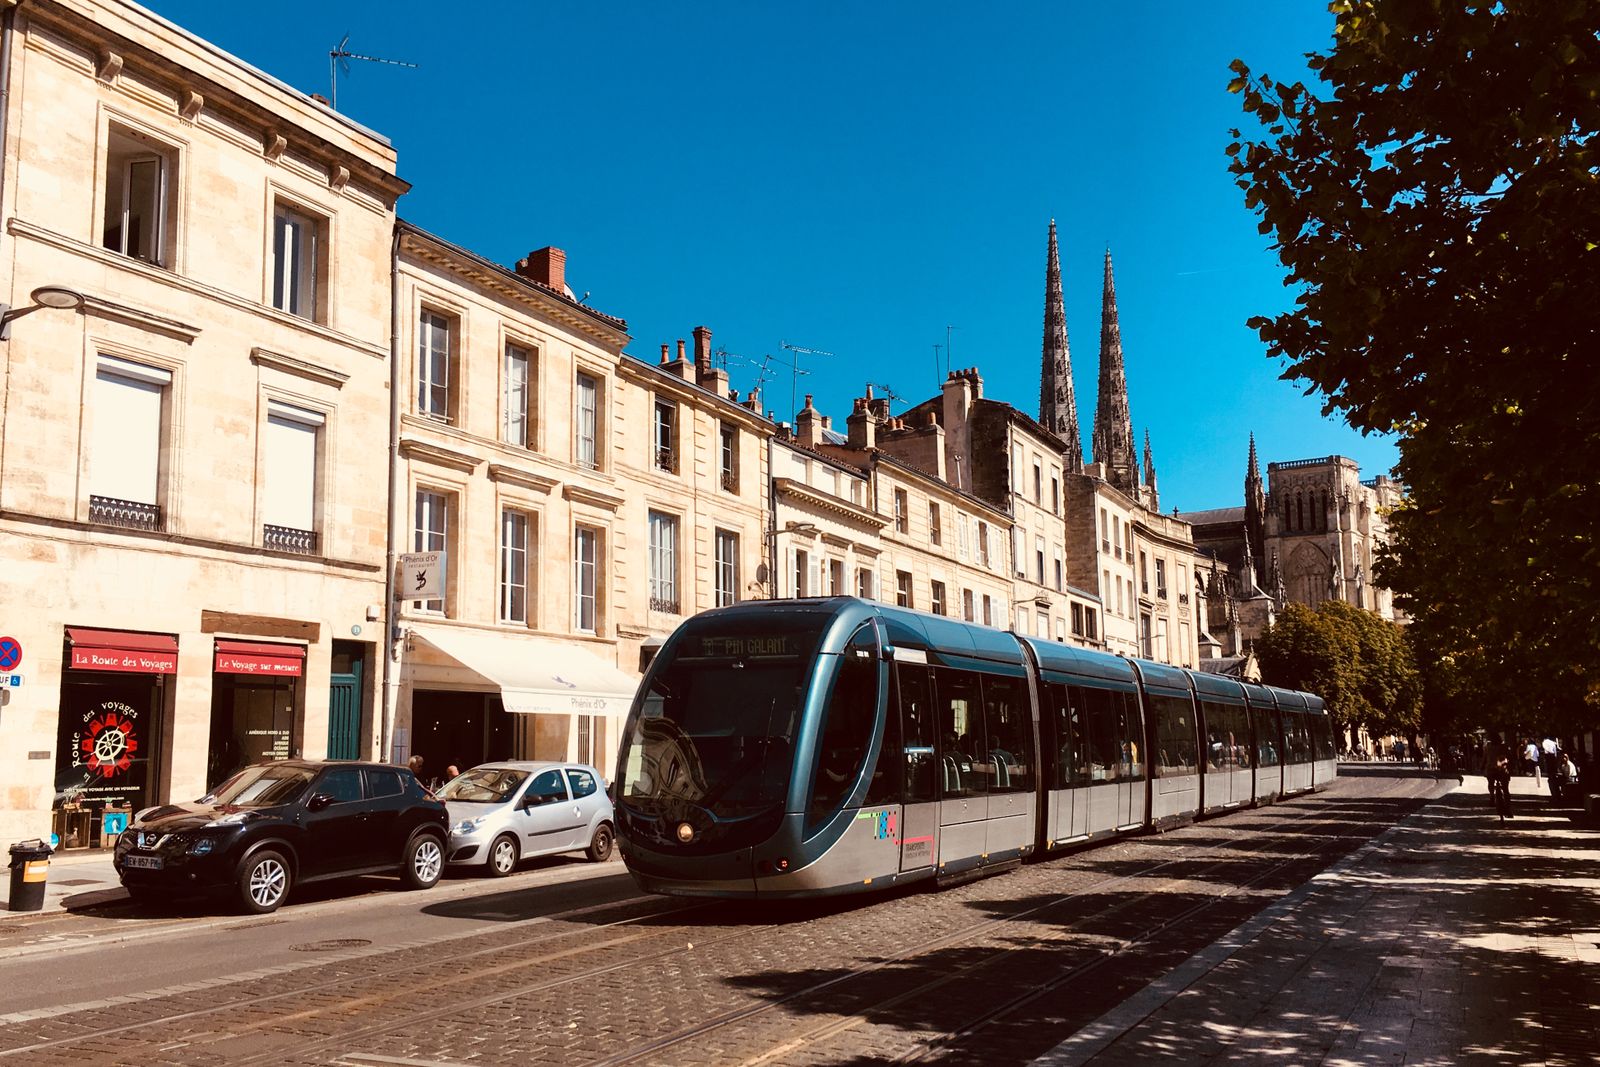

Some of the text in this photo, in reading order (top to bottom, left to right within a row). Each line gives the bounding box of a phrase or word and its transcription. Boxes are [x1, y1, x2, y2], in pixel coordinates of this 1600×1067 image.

[405, 554, 438, 563] Phénix d'Or
[725, 639, 744, 654] PIN
[747, 638, 786, 654] GALANT
[76, 654, 173, 672] La Route des Voyages
[219, 659, 299, 672] Le Voyage sur mesure
[571, 697, 608, 709] Phénix d'Or
[72, 732, 81, 768] Route
[83, 710, 95, 722] des
[101, 701, 138, 719] voyages
